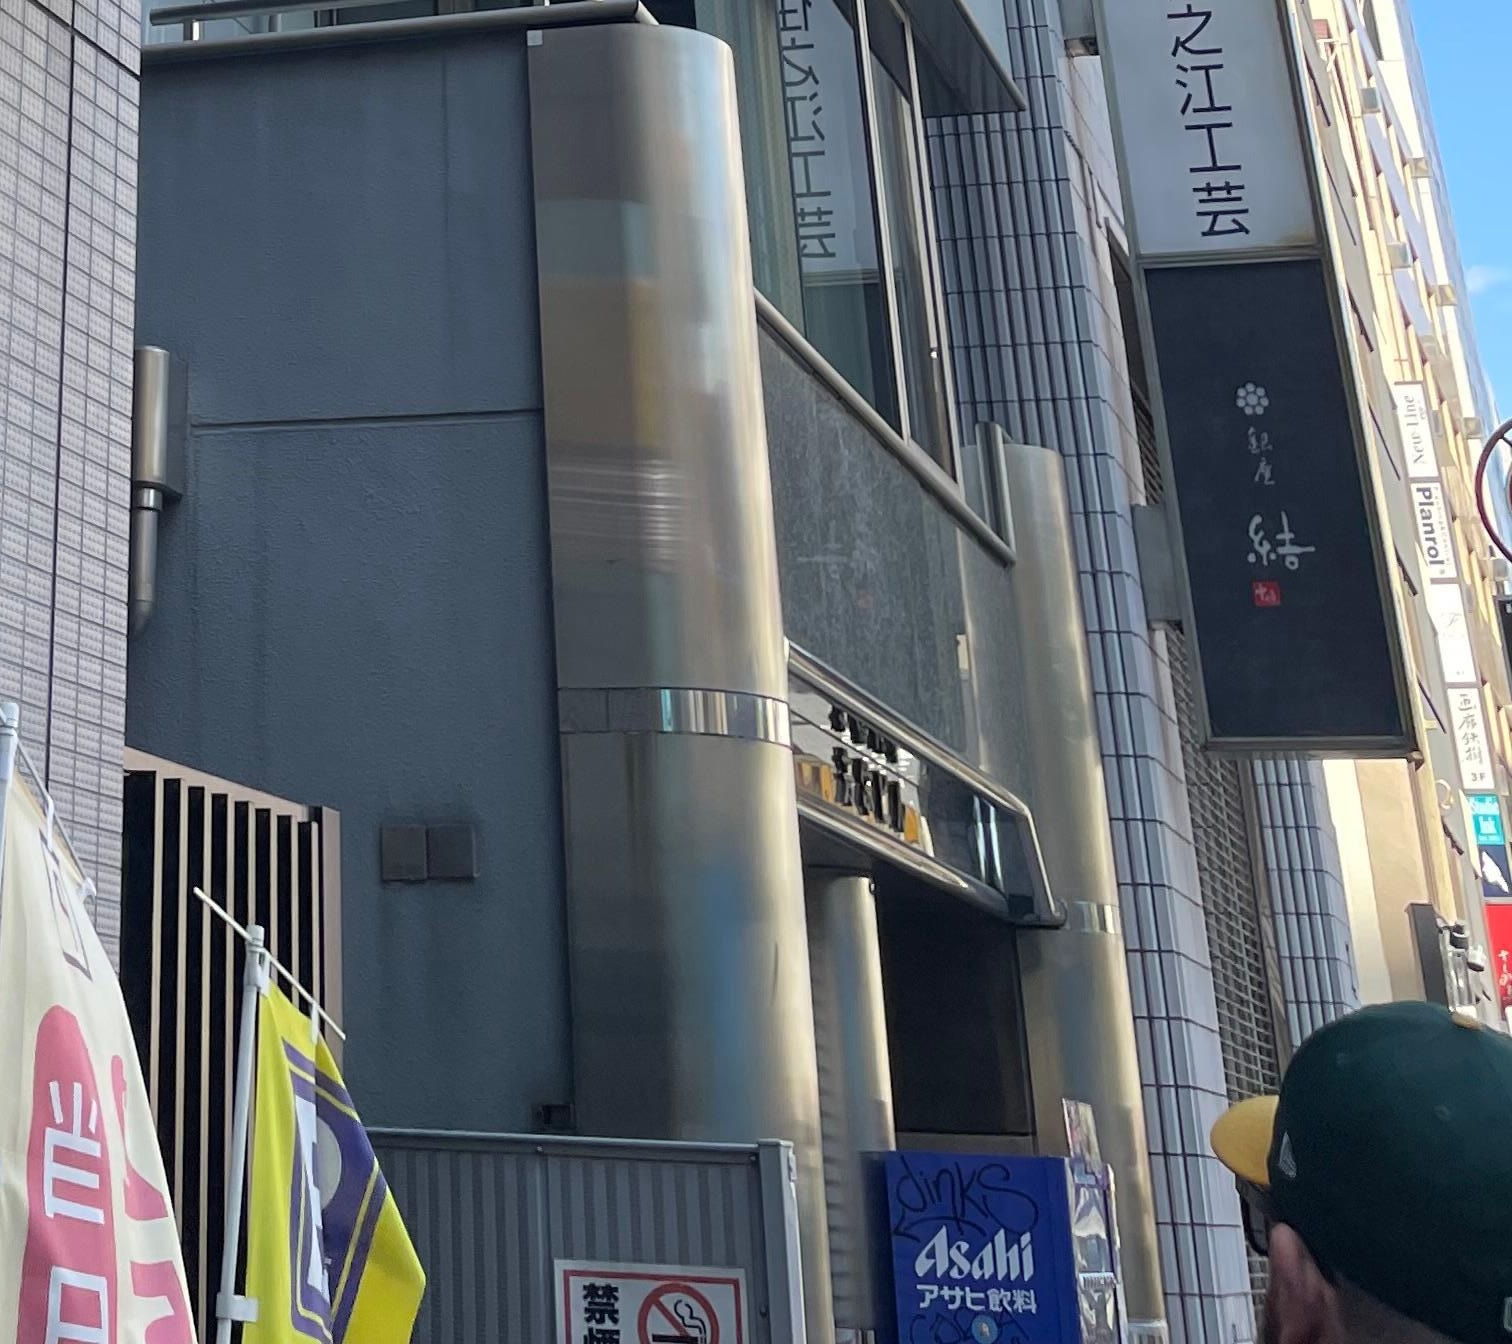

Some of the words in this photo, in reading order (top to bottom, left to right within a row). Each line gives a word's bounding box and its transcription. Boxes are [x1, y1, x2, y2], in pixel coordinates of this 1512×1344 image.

[1415, 485, 1446, 569] Planrol
[914, 1224, 1034, 1282] Asahi
[916, 1283, 1038, 1315] アサヒ飲料
